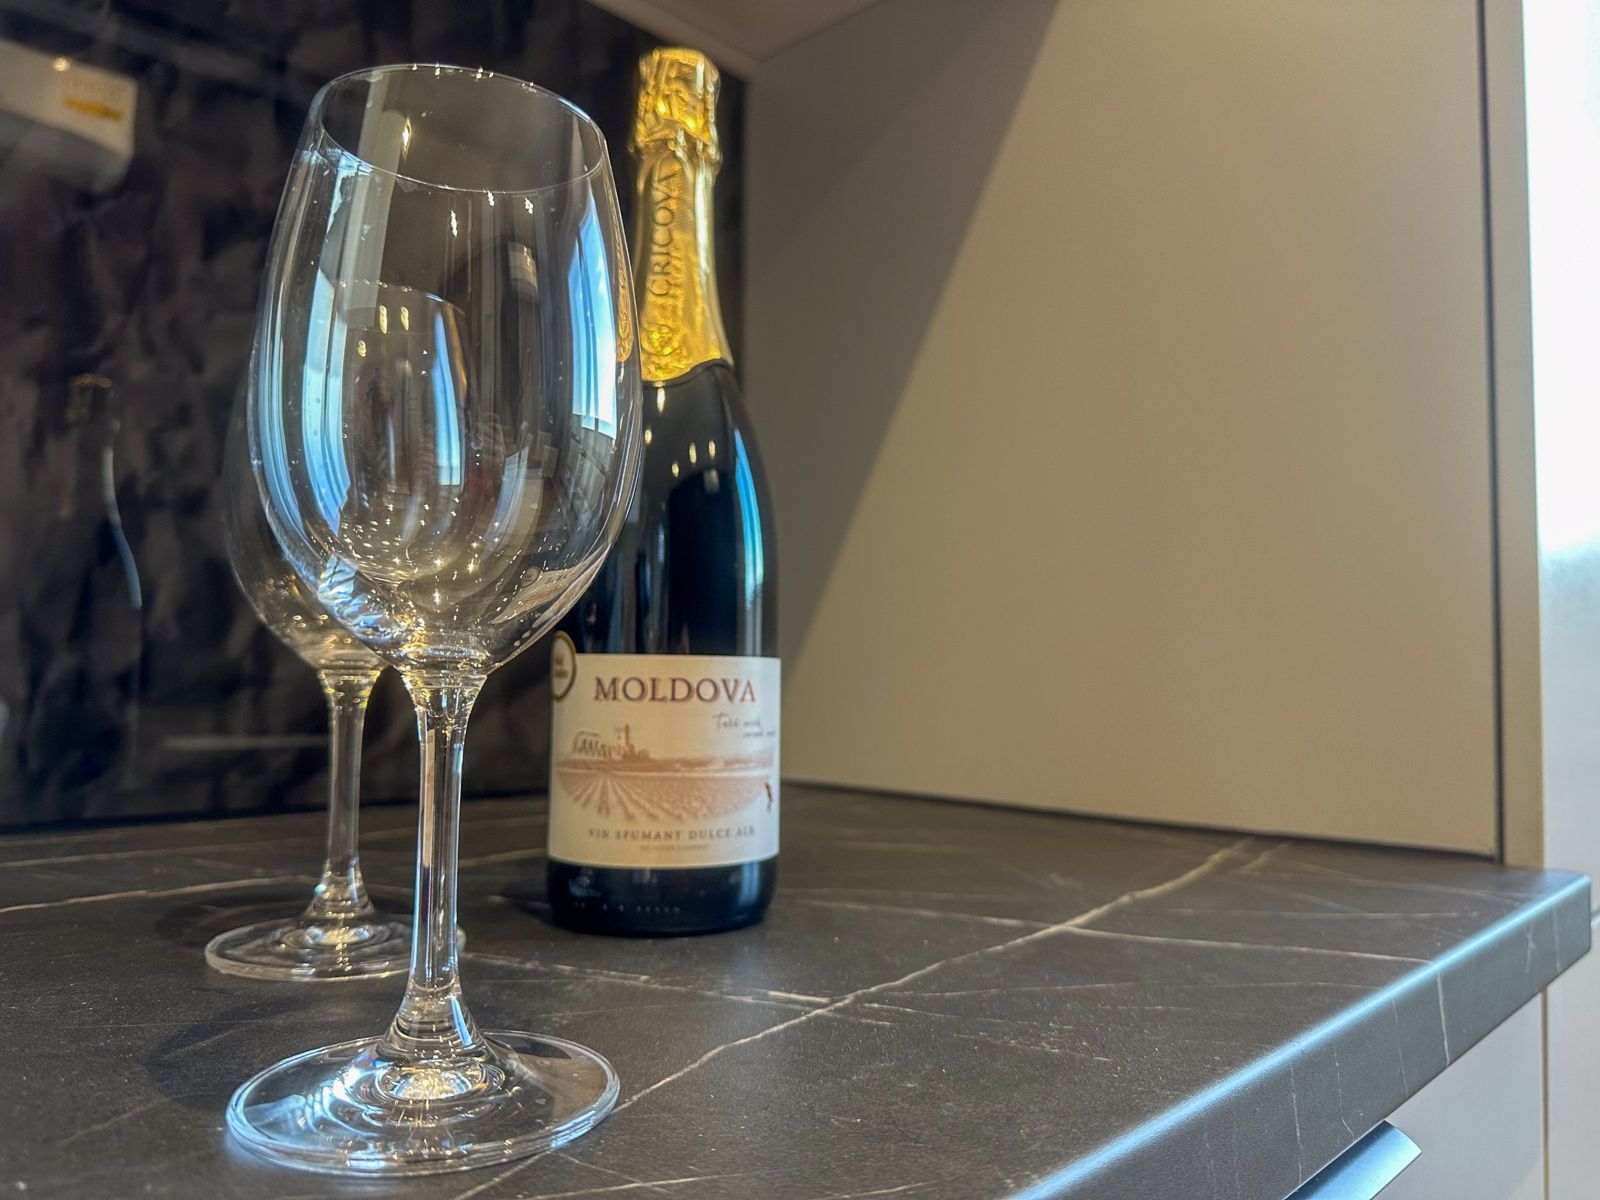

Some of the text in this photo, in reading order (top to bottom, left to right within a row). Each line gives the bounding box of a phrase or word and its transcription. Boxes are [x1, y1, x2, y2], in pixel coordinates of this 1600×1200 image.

[648, 172, 677, 296] CRICOVA
[594, 676, 756, 703] MOLDOVA
[588, 827, 610, 839] VIN
[615, 828, 682, 841] SPUMANT
[688, 827, 730, 840] DULCE
